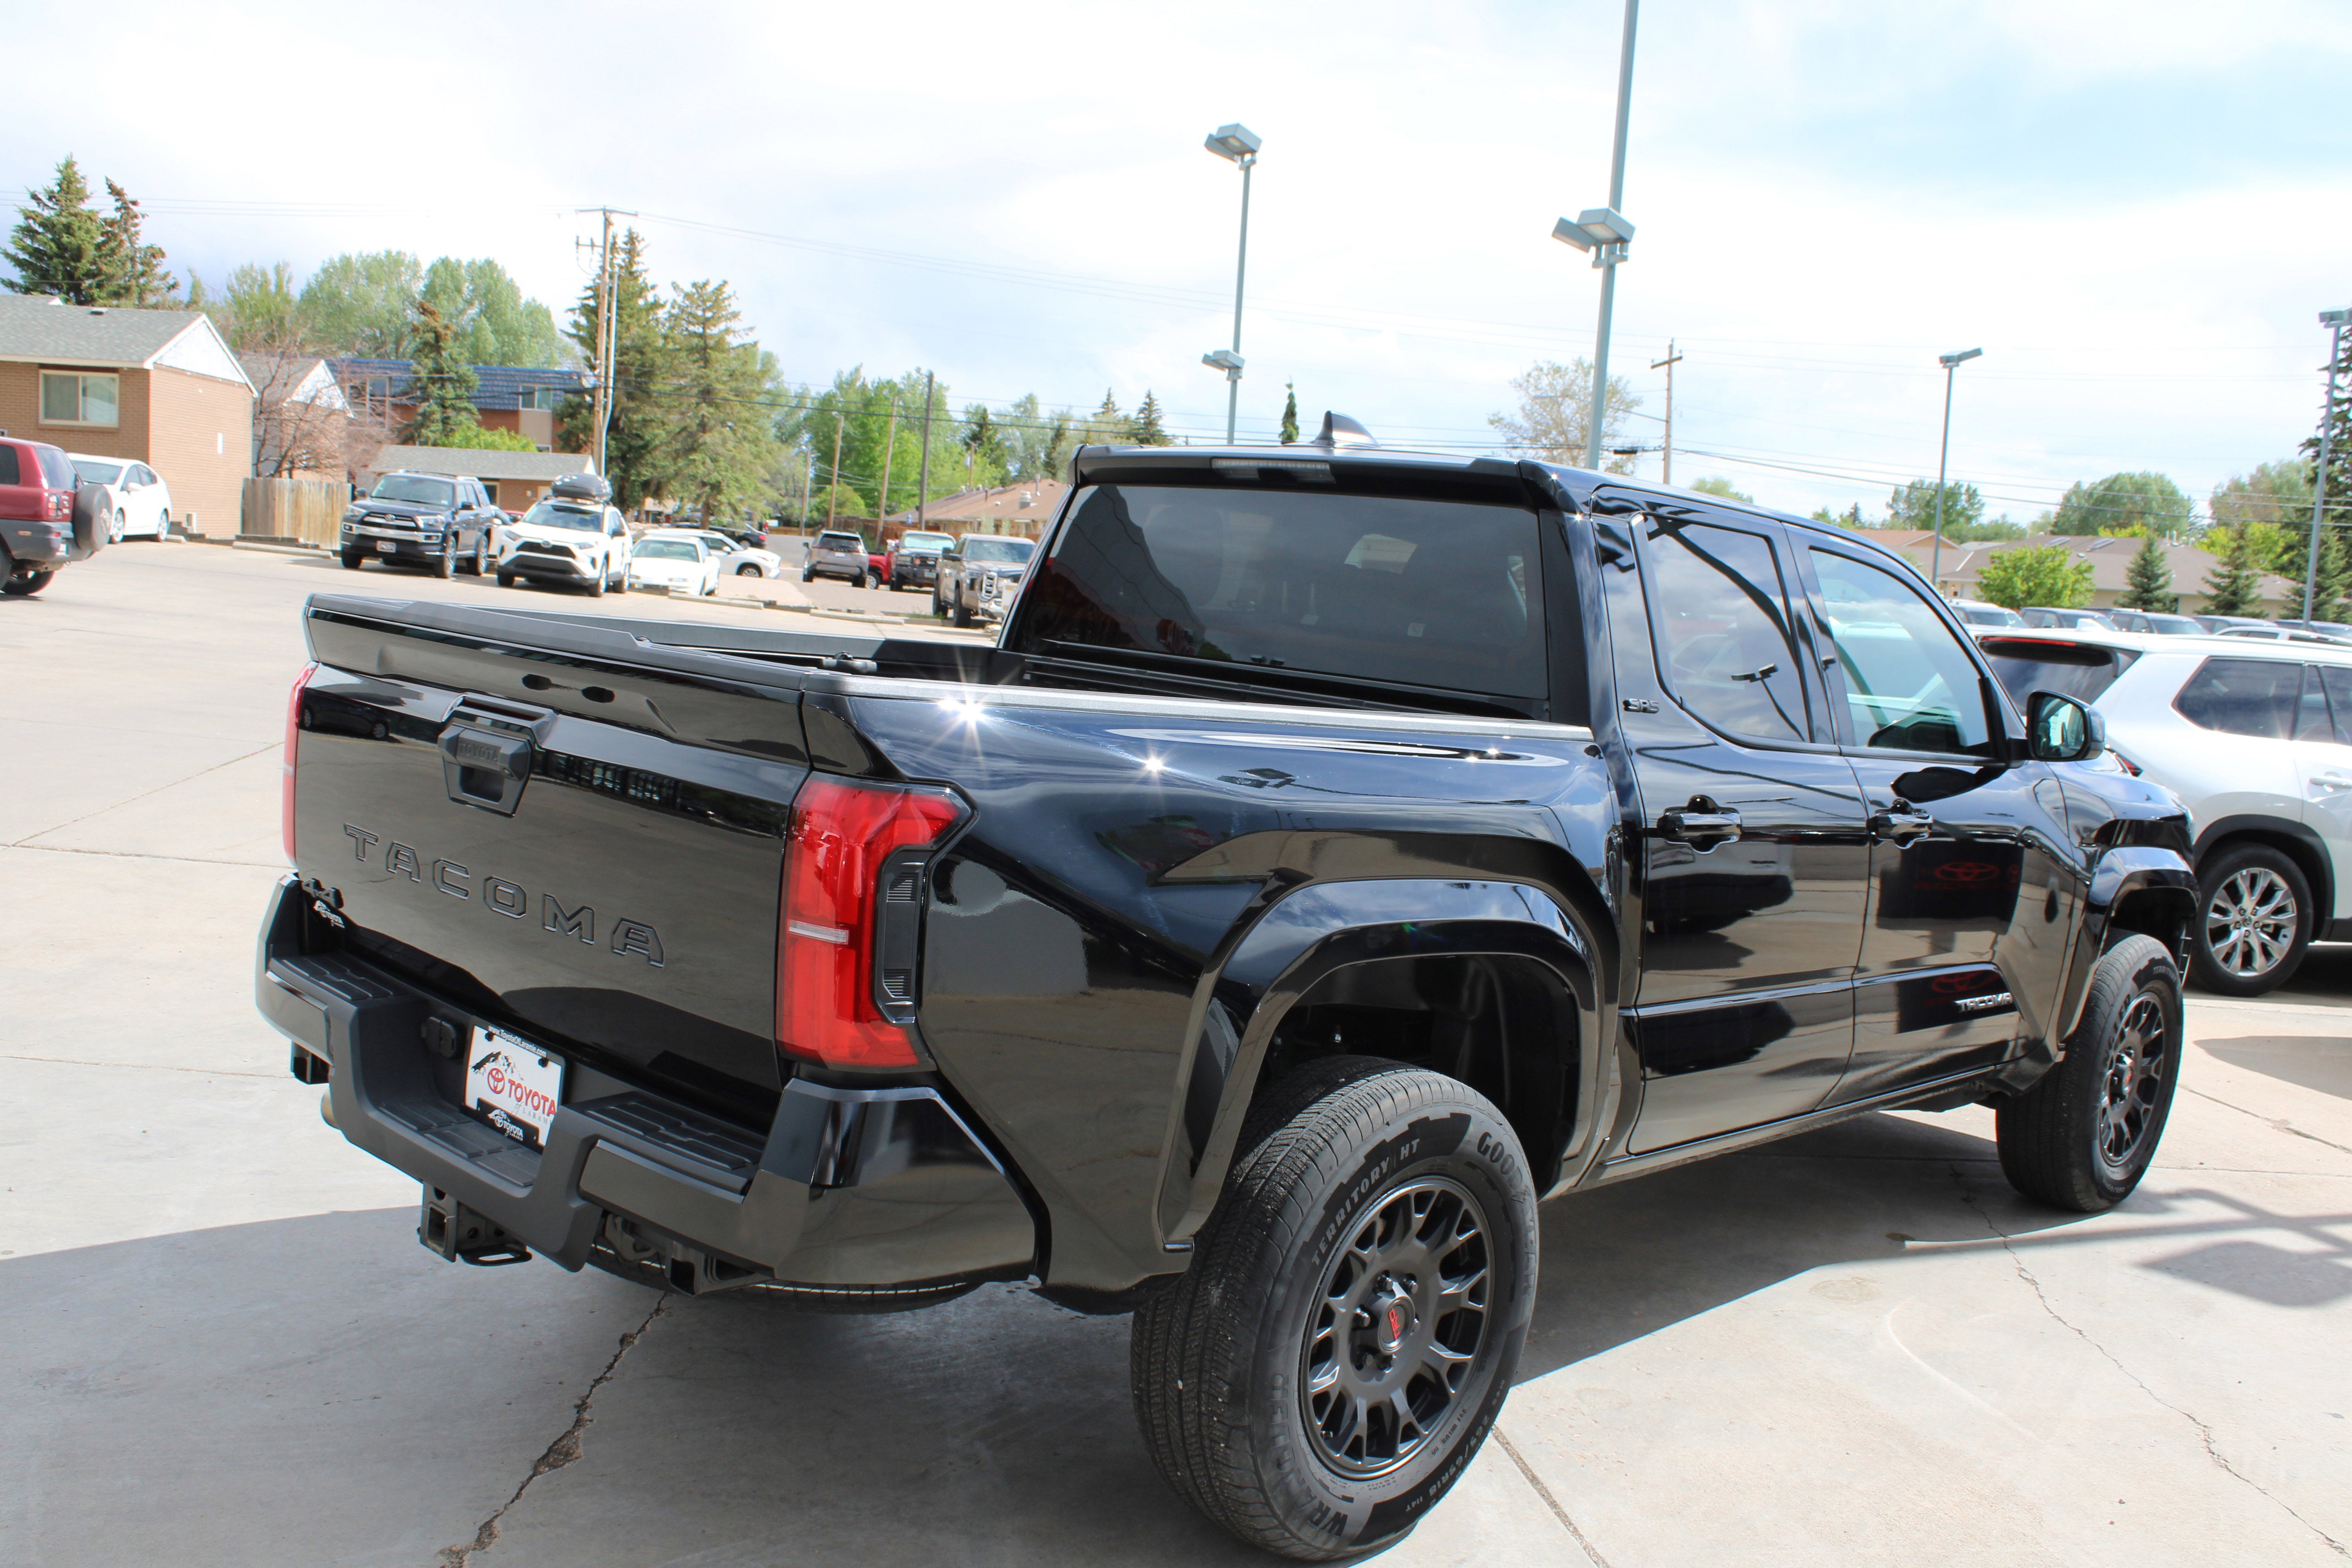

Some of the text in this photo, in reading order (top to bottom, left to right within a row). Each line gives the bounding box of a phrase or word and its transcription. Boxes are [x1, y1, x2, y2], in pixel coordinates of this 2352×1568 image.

[1623, 697, 1659, 714] SR5
[457, 742, 499, 763] TOYOTA
[343, 822, 665, 969] TACOMA
[1954, 992, 2013, 1012] TACOMA
[508, 1078, 557, 1117] TOYOTA
[503, 1120, 523, 1138] TOYOTA
[1311, 1138, 1420, 1265] TERRITORY HT
[1477, 1131, 1537, 1295] GOODYEAR
[1270, 1374, 1348, 1537] WRANGLER
[1428, 1414, 1489, 1497] 265/65R18
